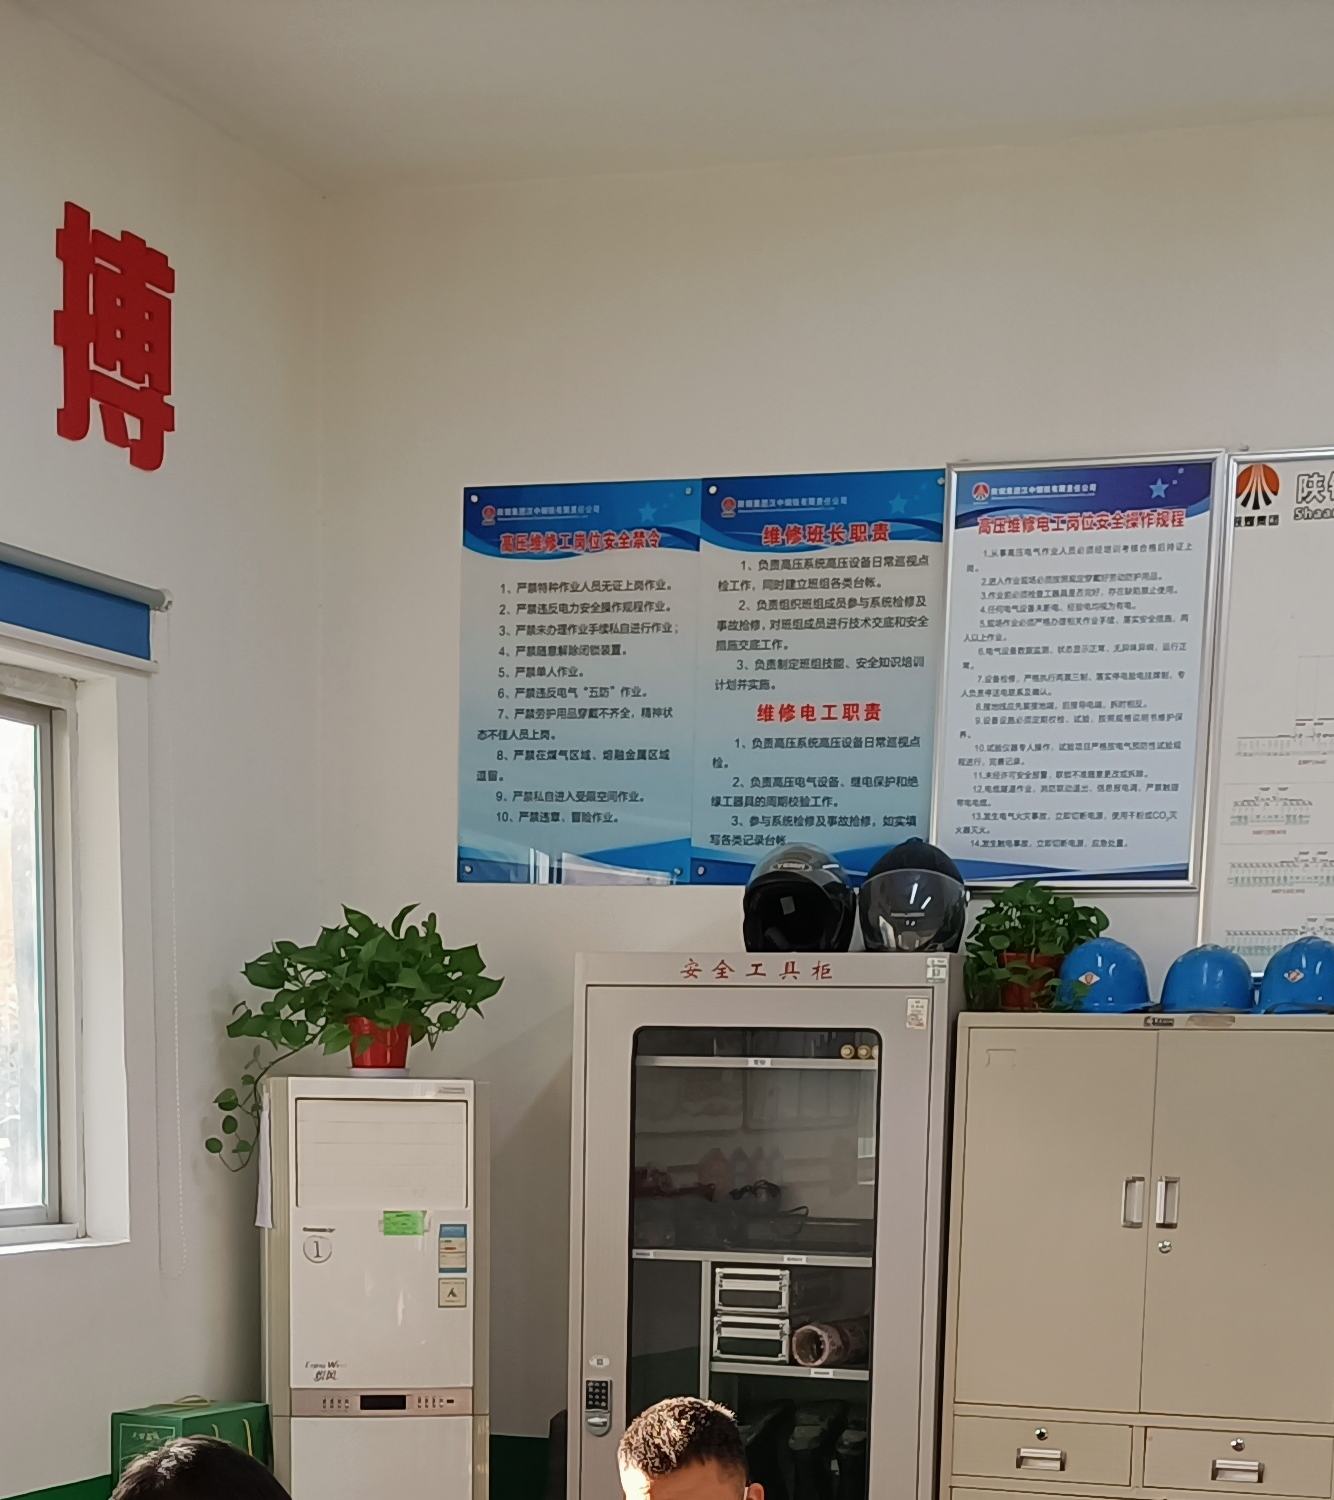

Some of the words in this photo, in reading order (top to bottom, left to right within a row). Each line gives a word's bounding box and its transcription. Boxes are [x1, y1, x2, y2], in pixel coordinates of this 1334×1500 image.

[762, 522, 891, 546] 维修班长职责
[978, 509, 1186, 535] 高压维修电工岗位安全操作规程
[500, 529, 661, 554] 高压维修工岗位安全禁令
[756, 702, 882, 723] 维修电工职责
[679, 958, 833, 981] 安全工具柜
